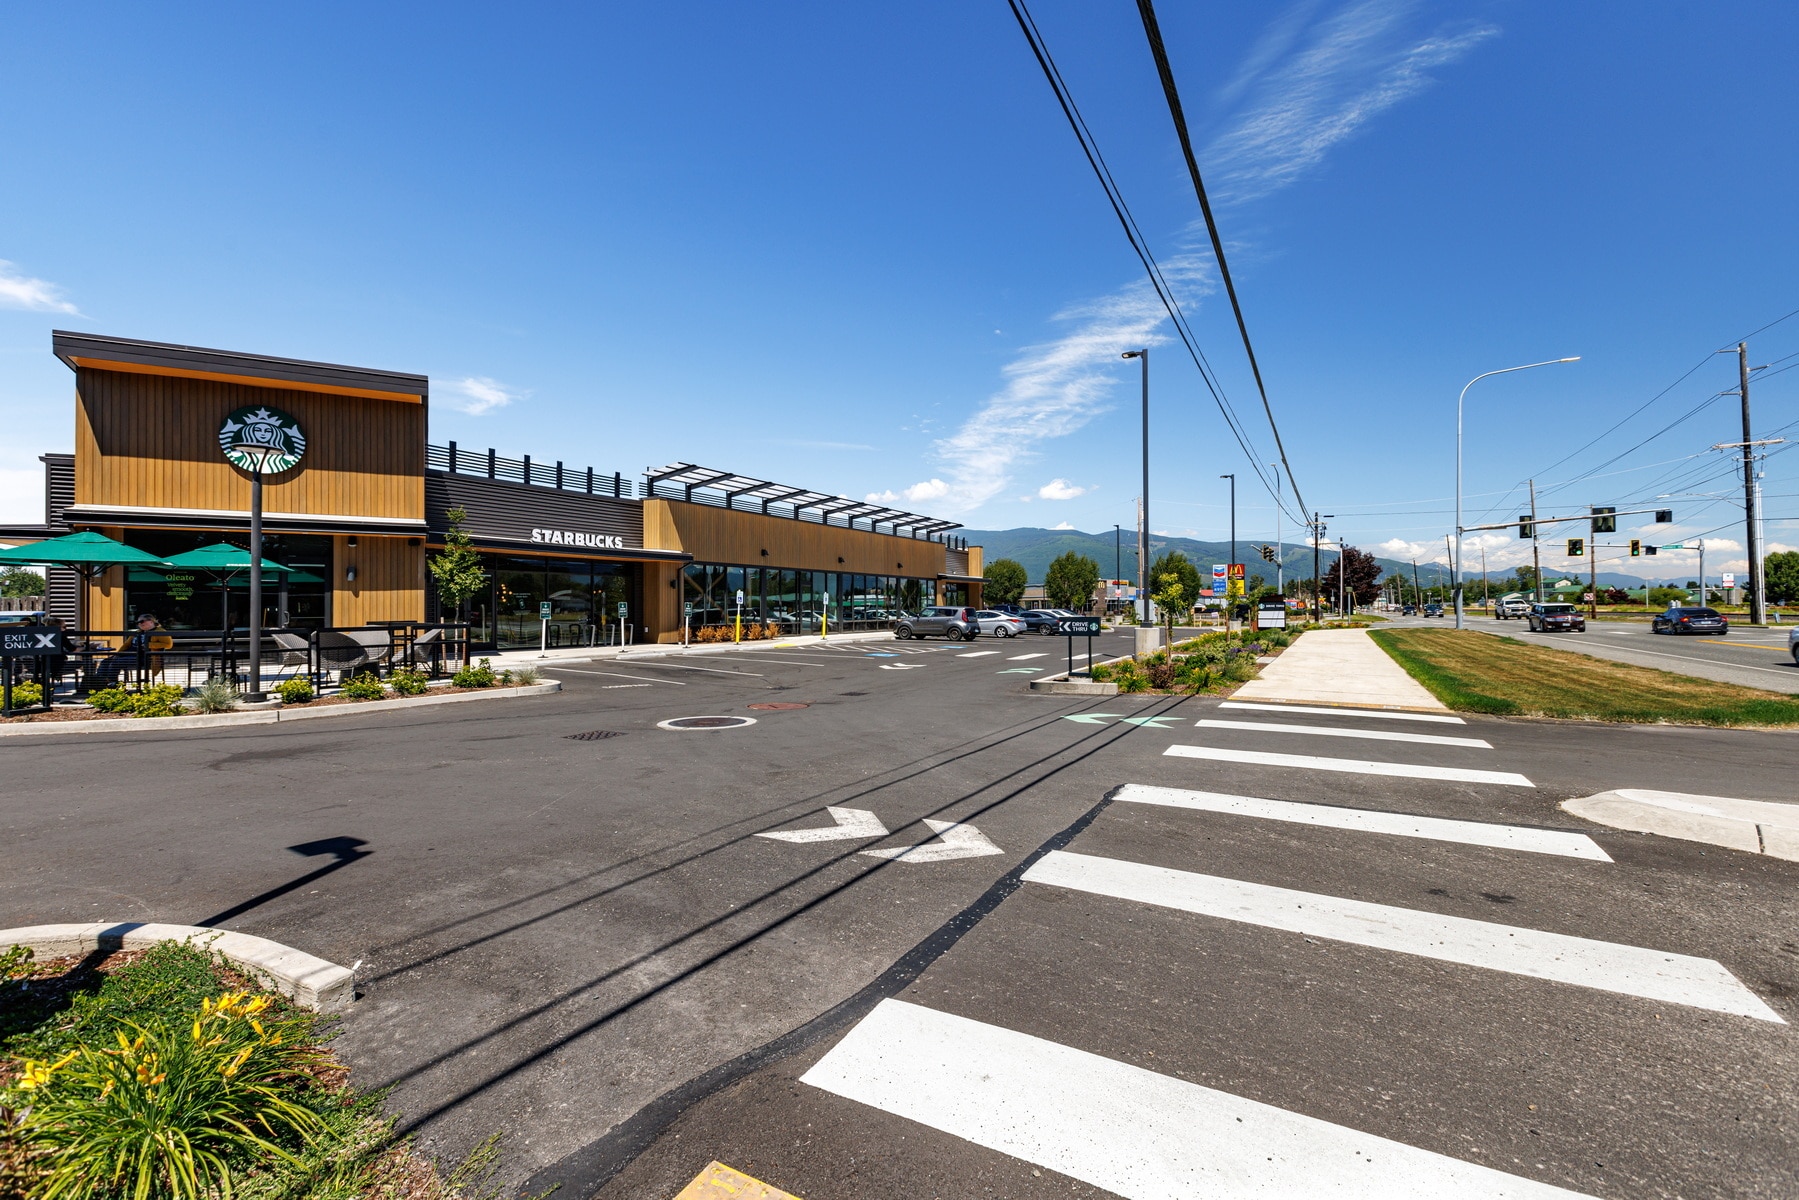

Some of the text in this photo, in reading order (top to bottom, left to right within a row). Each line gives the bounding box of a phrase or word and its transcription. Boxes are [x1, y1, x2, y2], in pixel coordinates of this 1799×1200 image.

[531, 528, 623, 549] STARBUCKS
[165, 573, 195, 582] Oleato
[4, 634, 28, 642] EXIT
[4, 641, 33, 650] ONLY
